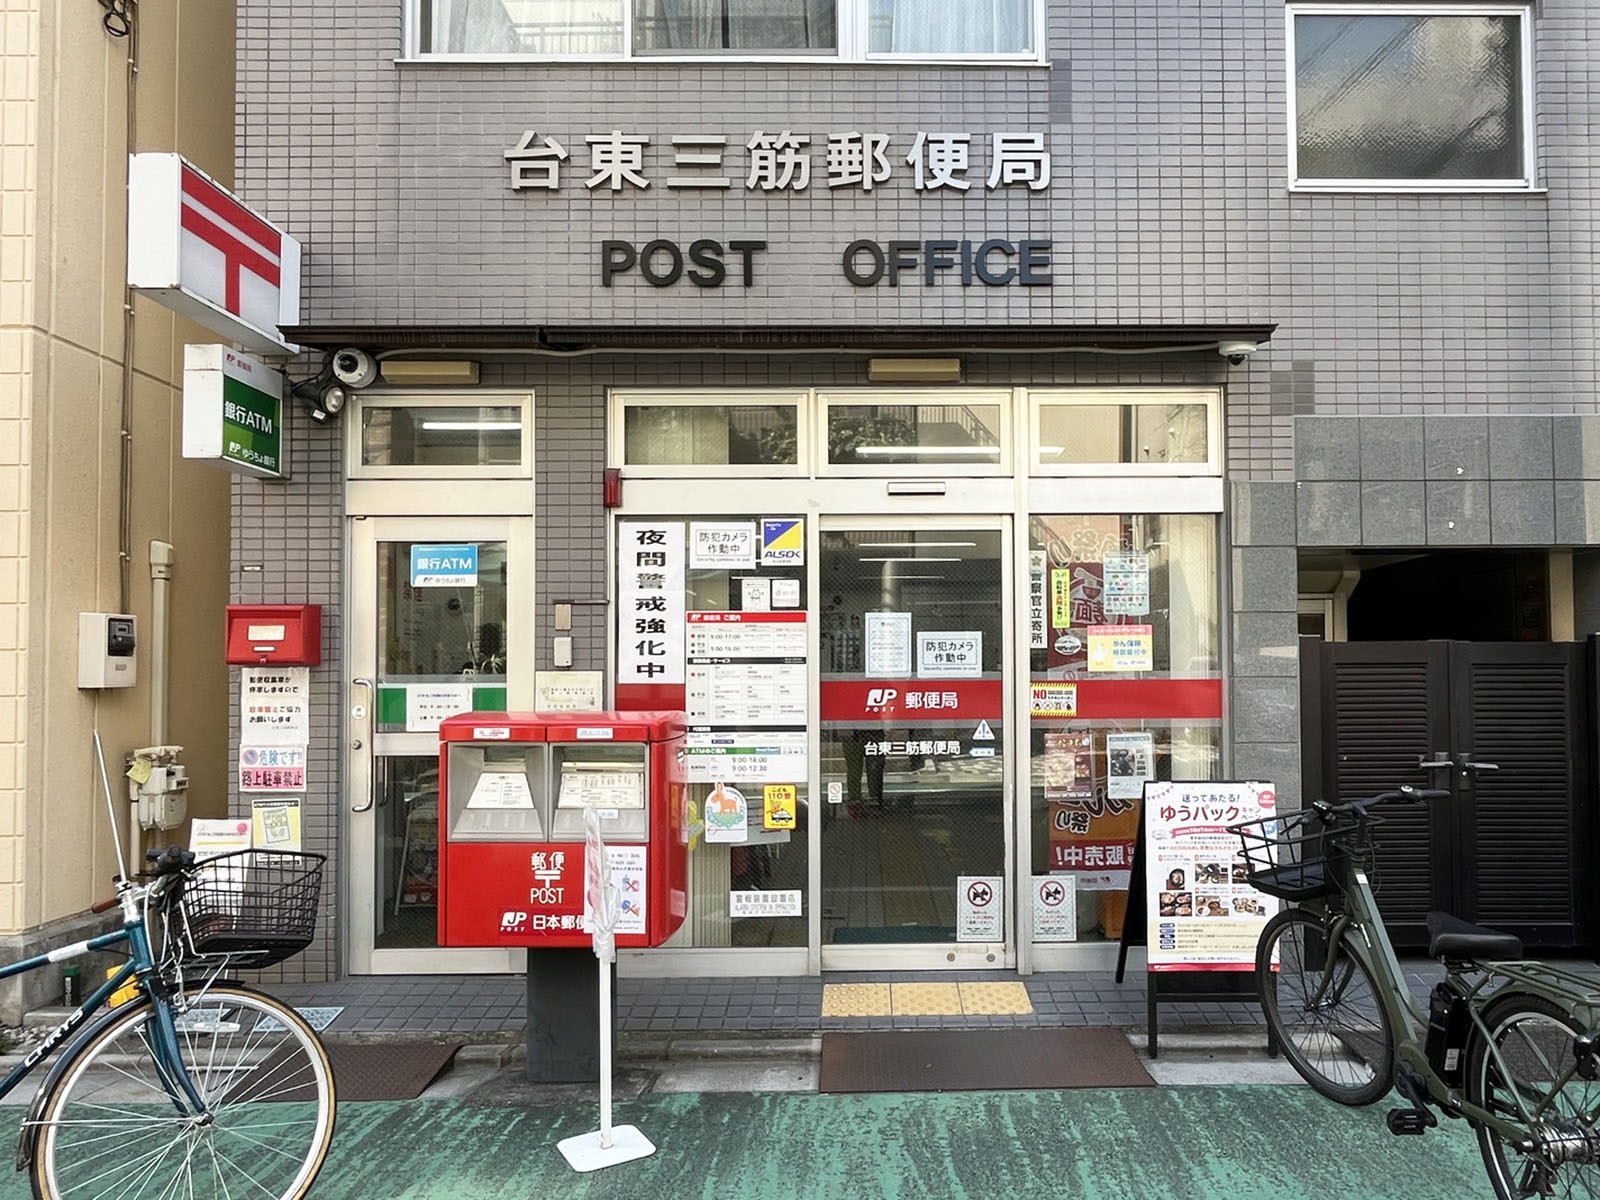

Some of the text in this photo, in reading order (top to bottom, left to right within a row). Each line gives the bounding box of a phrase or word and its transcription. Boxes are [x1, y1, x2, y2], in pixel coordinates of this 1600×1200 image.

[503, 130, 1051, 192] 台東三筋郵便局
[601, 239, 1054, 288] POST OFFICE
[225, 401, 272, 434] 銀行ATM
[699, 532, 748, 542] 防犯カメラ
[708, 544, 740, 554] 作動中
[417, 558, 472, 570] 銀行ATM
[635, 529, 667, 678] 夜間警戒強化中
[926, 641, 974, 652] 防犯カメラ
[935, 653, 967, 663] 作動中
[905, 691, 958, 709] 郵便局
[1033, 690, 1047, 700] NO
[864, 741, 961, 756] 台東三筋郵便局
[242, 770, 303, 787] 路上駐車禁止
[1182, 794, 1240, 803] 送ってあたる!
[1160, 805, 1240, 822] ゆうパック
[531, 852, 565, 871] 郵便
[531, 888, 564, 904] POST
